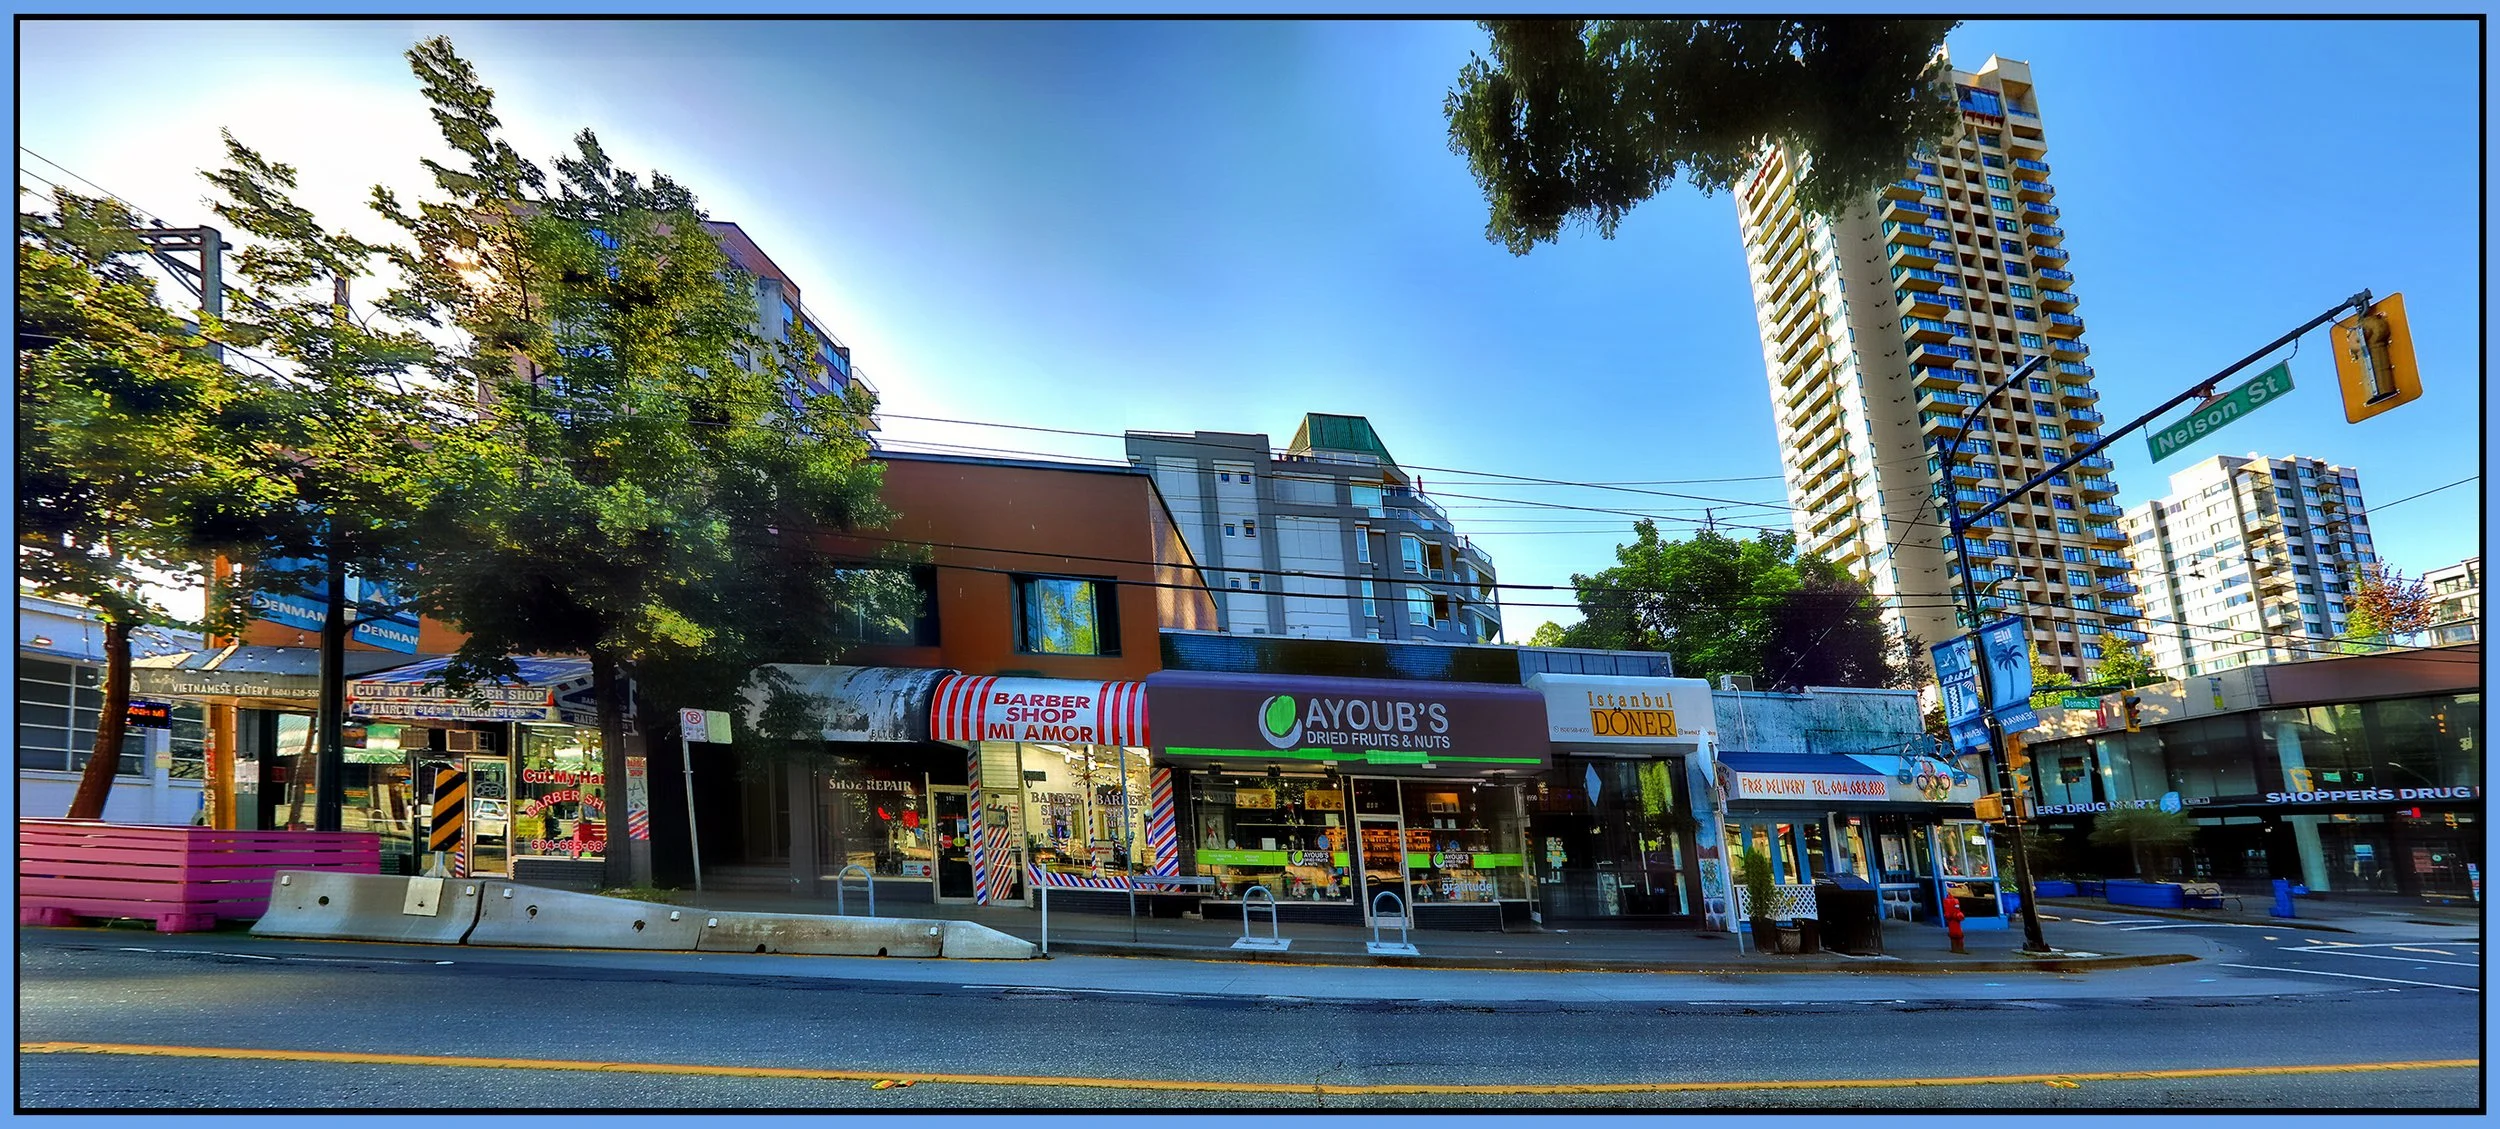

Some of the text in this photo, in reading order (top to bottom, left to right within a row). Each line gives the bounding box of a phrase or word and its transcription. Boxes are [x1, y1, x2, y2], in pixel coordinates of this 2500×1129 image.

[2158, 376, 2279, 453] Nelson St
[258, 597, 327, 623] DENMAN
[358, 623, 419, 646] DENMAN
[172, 683, 321, 698] VIETNAMESE EATERY (604) 620-555
[355, 685, 384, 697] CUT
[388, 686, 408, 697] MY
[508, 690, 545, 700] SHOP
[993, 692, 1090, 709] BARBER
[1587, 690, 1673, 709] Istanbul
[2064, 699, 2098, 709] Denman St
[573, 713, 599, 725] HAIRC
[1005, 707, 1077, 724] SHOP
[1305, 696, 1449, 733] AYOUB'S
[1593, 706, 1676, 736] DÖNER
[988, 723, 1094, 743] MI AMOR
[1307, 730, 1451, 749] DRIED FRUITS & NUTS
[523, 768, 553, 784] Cut
[554, 769, 579, 786] My
[829, 778, 913, 792] SHOE REPAIR
[475, 785, 504, 797] OPEN
[1742, 777, 1764, 794] FREE
[1765, 778, 1806, 795] DELIVERY
[2400, 786, 2471, 800] DRUG
[525, 789, 580, 818] BARBER
[1031, 791, 1083, 804] BARBER
[1041, 804, 1074, 816] SHOP
[2036, 804, 2065, 815] ERS
[2066, 802, 2107, 814] DRUG
[1304, 851, 1329, 859] AYOUB'S
[1442, 879, 1493, 895] gratitude
